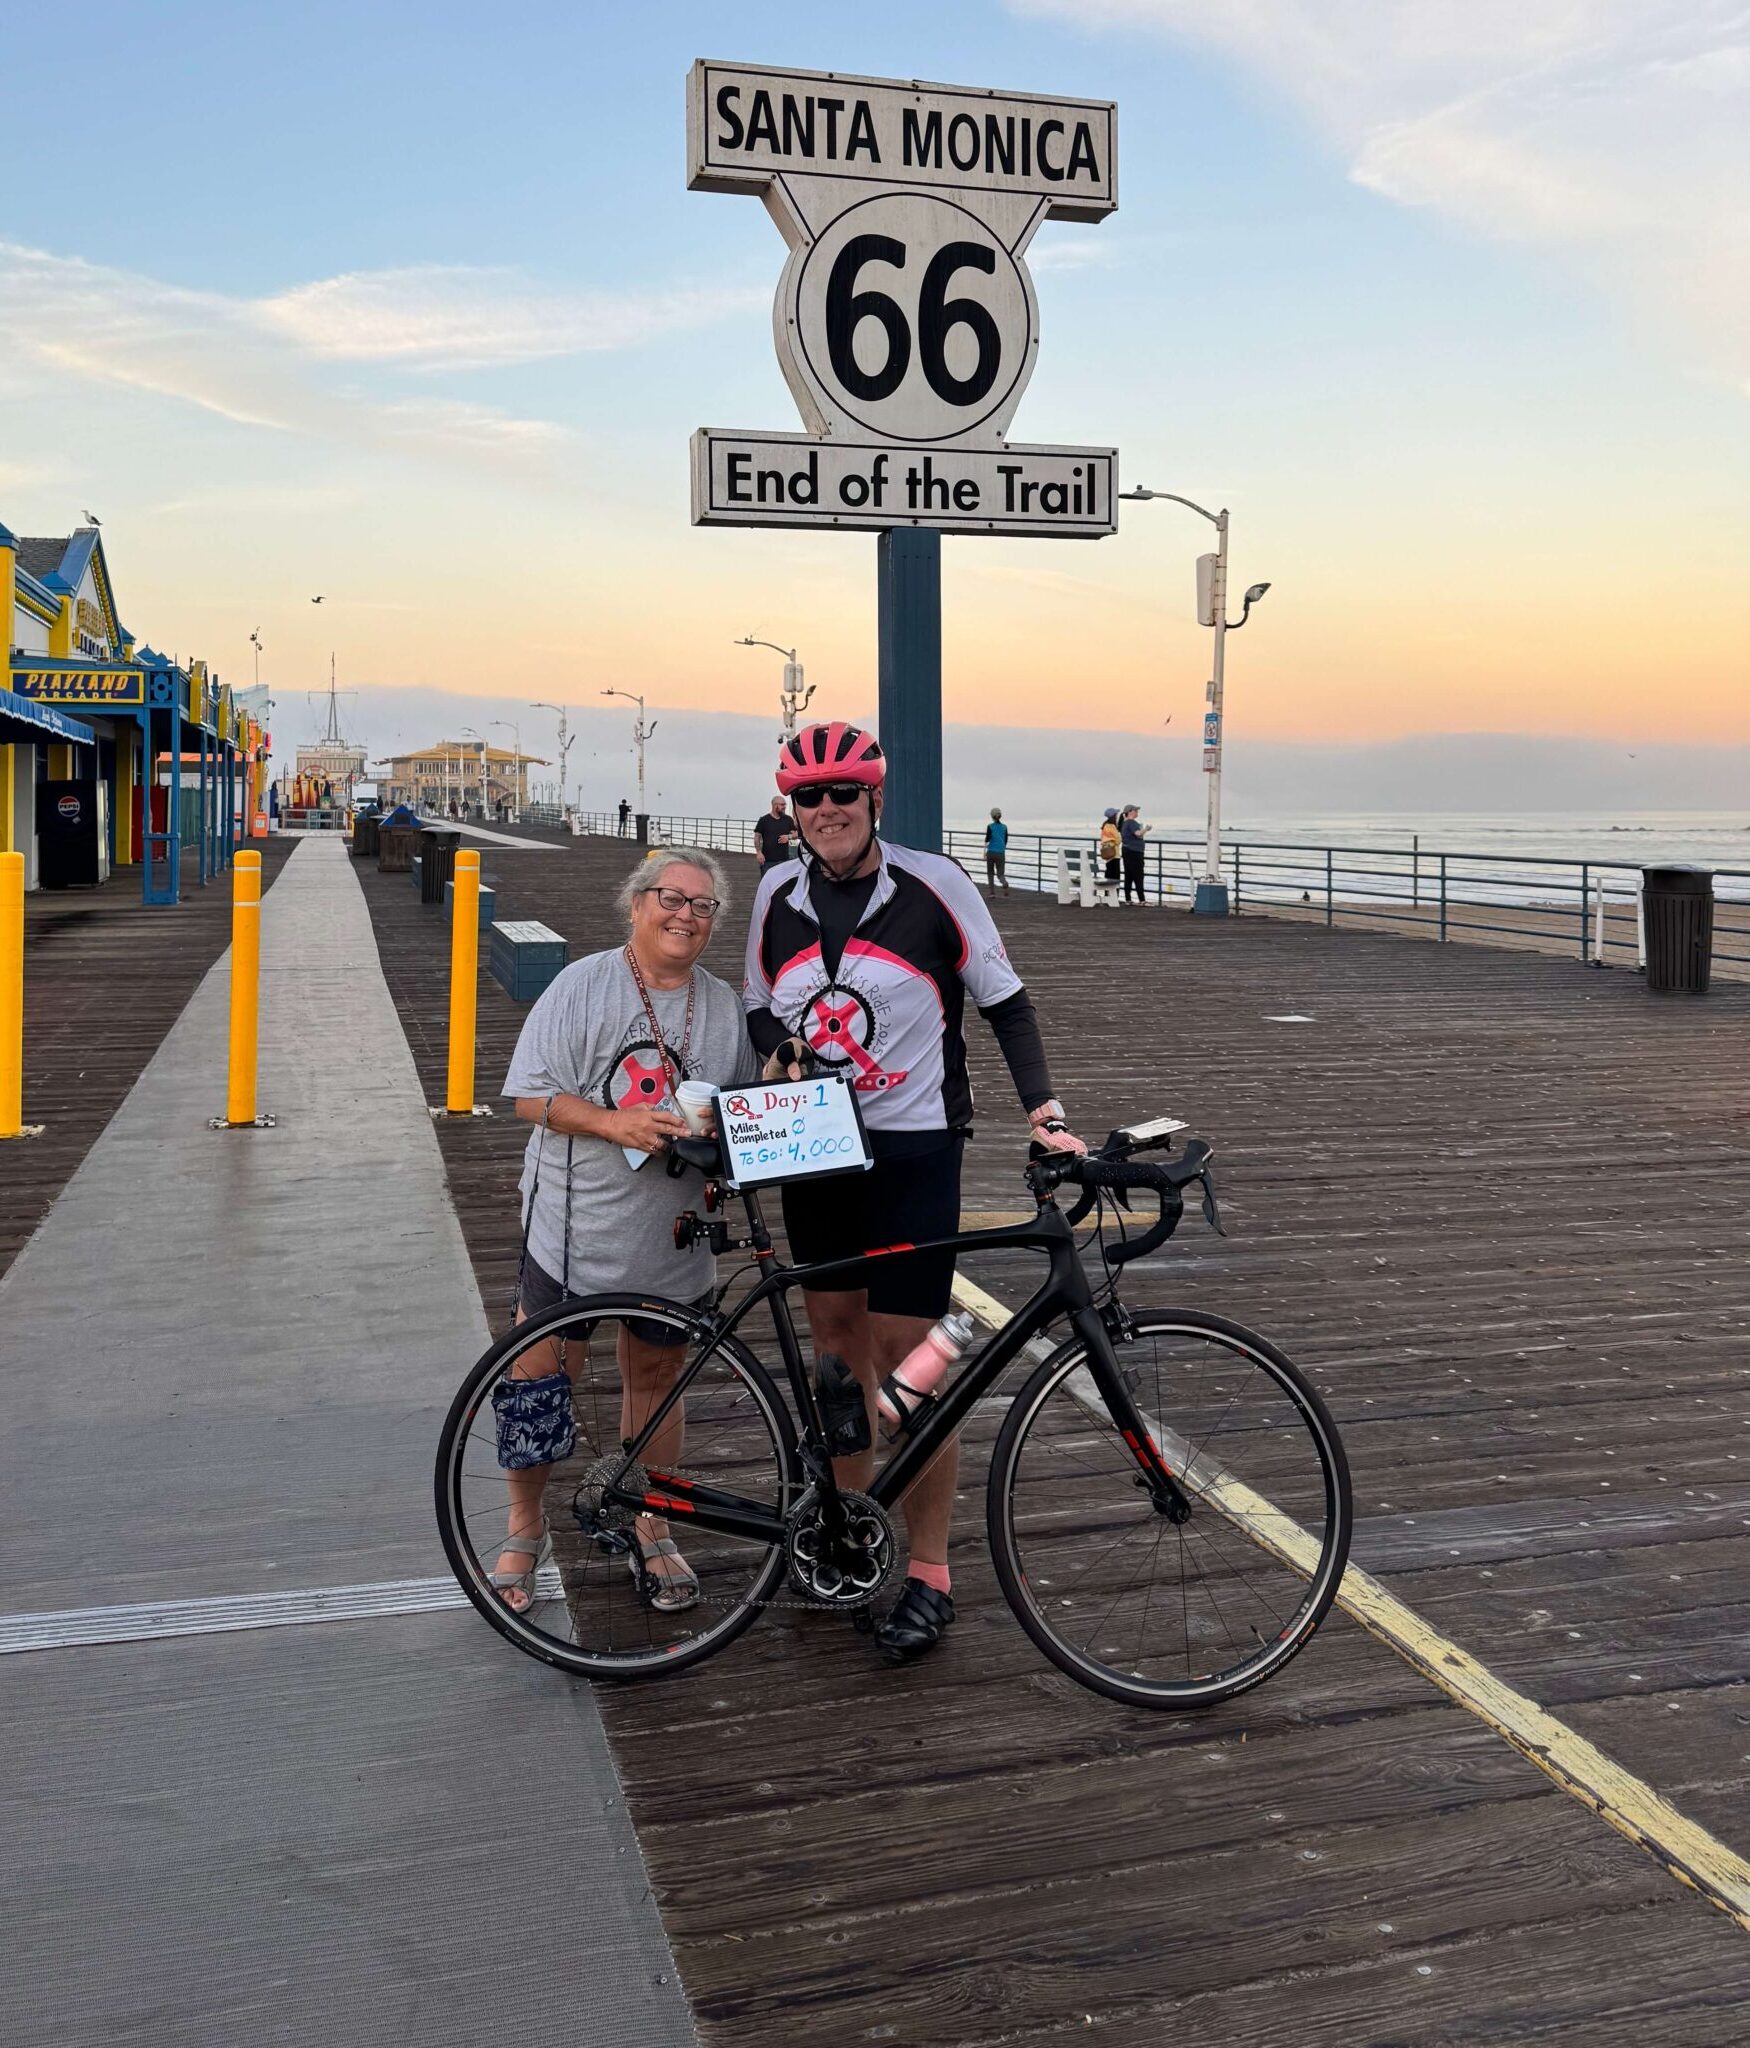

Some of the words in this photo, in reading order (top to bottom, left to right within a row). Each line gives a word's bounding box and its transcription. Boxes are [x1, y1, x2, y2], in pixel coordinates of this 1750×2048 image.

[715, 85, 881, 163] SANTA
[902, 108, 1101, 182] MONICA
[825, 233, 1002, 406] 66
[726, 451, 818, 504] End
[839, 453, 889, 507] of
[905, 456, 980, 511] the
[997, 463, 1096, 515] Trail
[25, 673, 129, 690] PLAYLAND
[39, 691, 112, 699] ARCADE
[646, 1006, 666, 1057] UNIVERSITY
[872, 1022, 891, 1055] 2025
[763, 1091, 808, 1112] Day:
[813, 1084, 829, 1107] 1
[729, 1122, 760, 1135] Miles
[732, 1128, 787, 1145] Completed
[739, 1151, 754, 1165] To
[757, 1148, 783, 1163] Go:
[788, 1136, 854, 1162] 4,000
